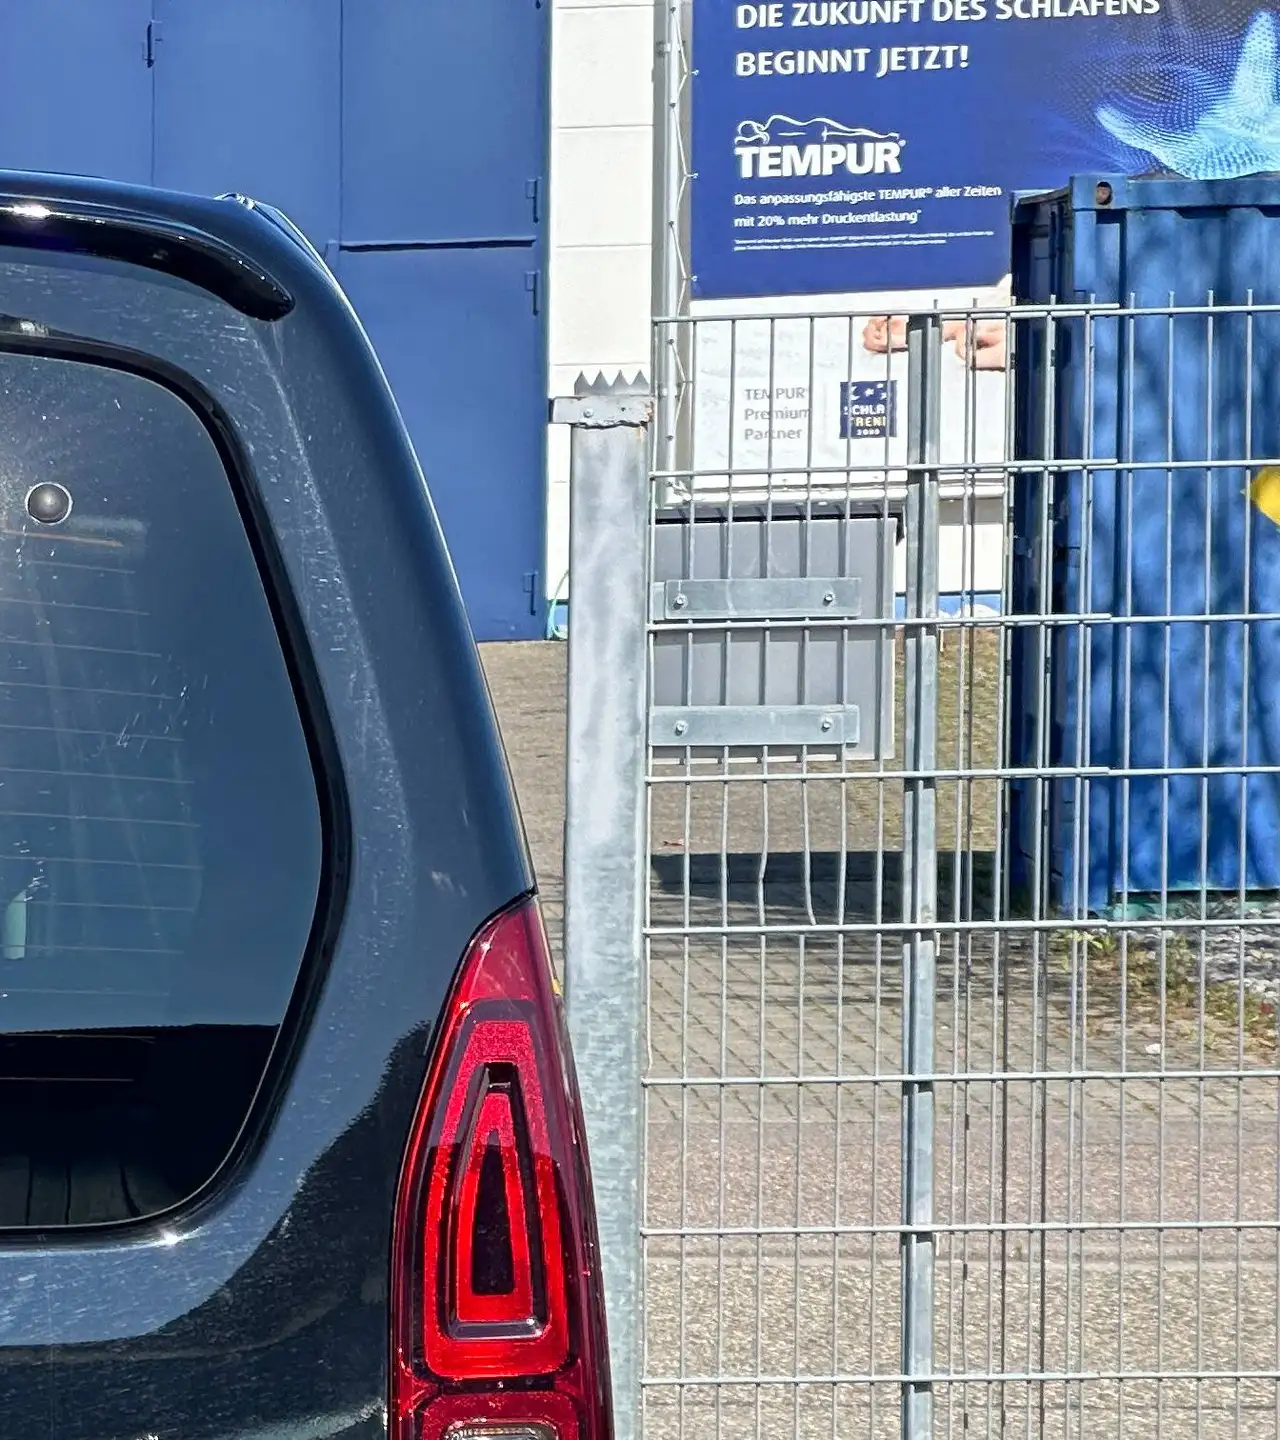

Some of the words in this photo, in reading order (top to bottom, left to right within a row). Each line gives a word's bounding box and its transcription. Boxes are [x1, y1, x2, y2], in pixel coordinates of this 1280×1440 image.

[736, 2, 784, 28] DIE
[791, 0, 922, 27] ZUKUNFT
[932, 0, 988, 22] DES
[995, 0, 1160, 20] SCHLAFENS
[735, 48, 870, 77] BEGINNT
[876, 45, 969, 78] JETZT!
[734, 142, 902, 178] TEMPUR
[734, 194, 757, 206] Das
[759, 189, 876, 206] anpassungsfähigste
[935, 186, 962, 198] aller
[963, 185, 1002, 197] Zeiten
[734, 216, 755, 227] mit
[757, 215, 785, 227] 20%
[788, 213, 820, 226] mehr
